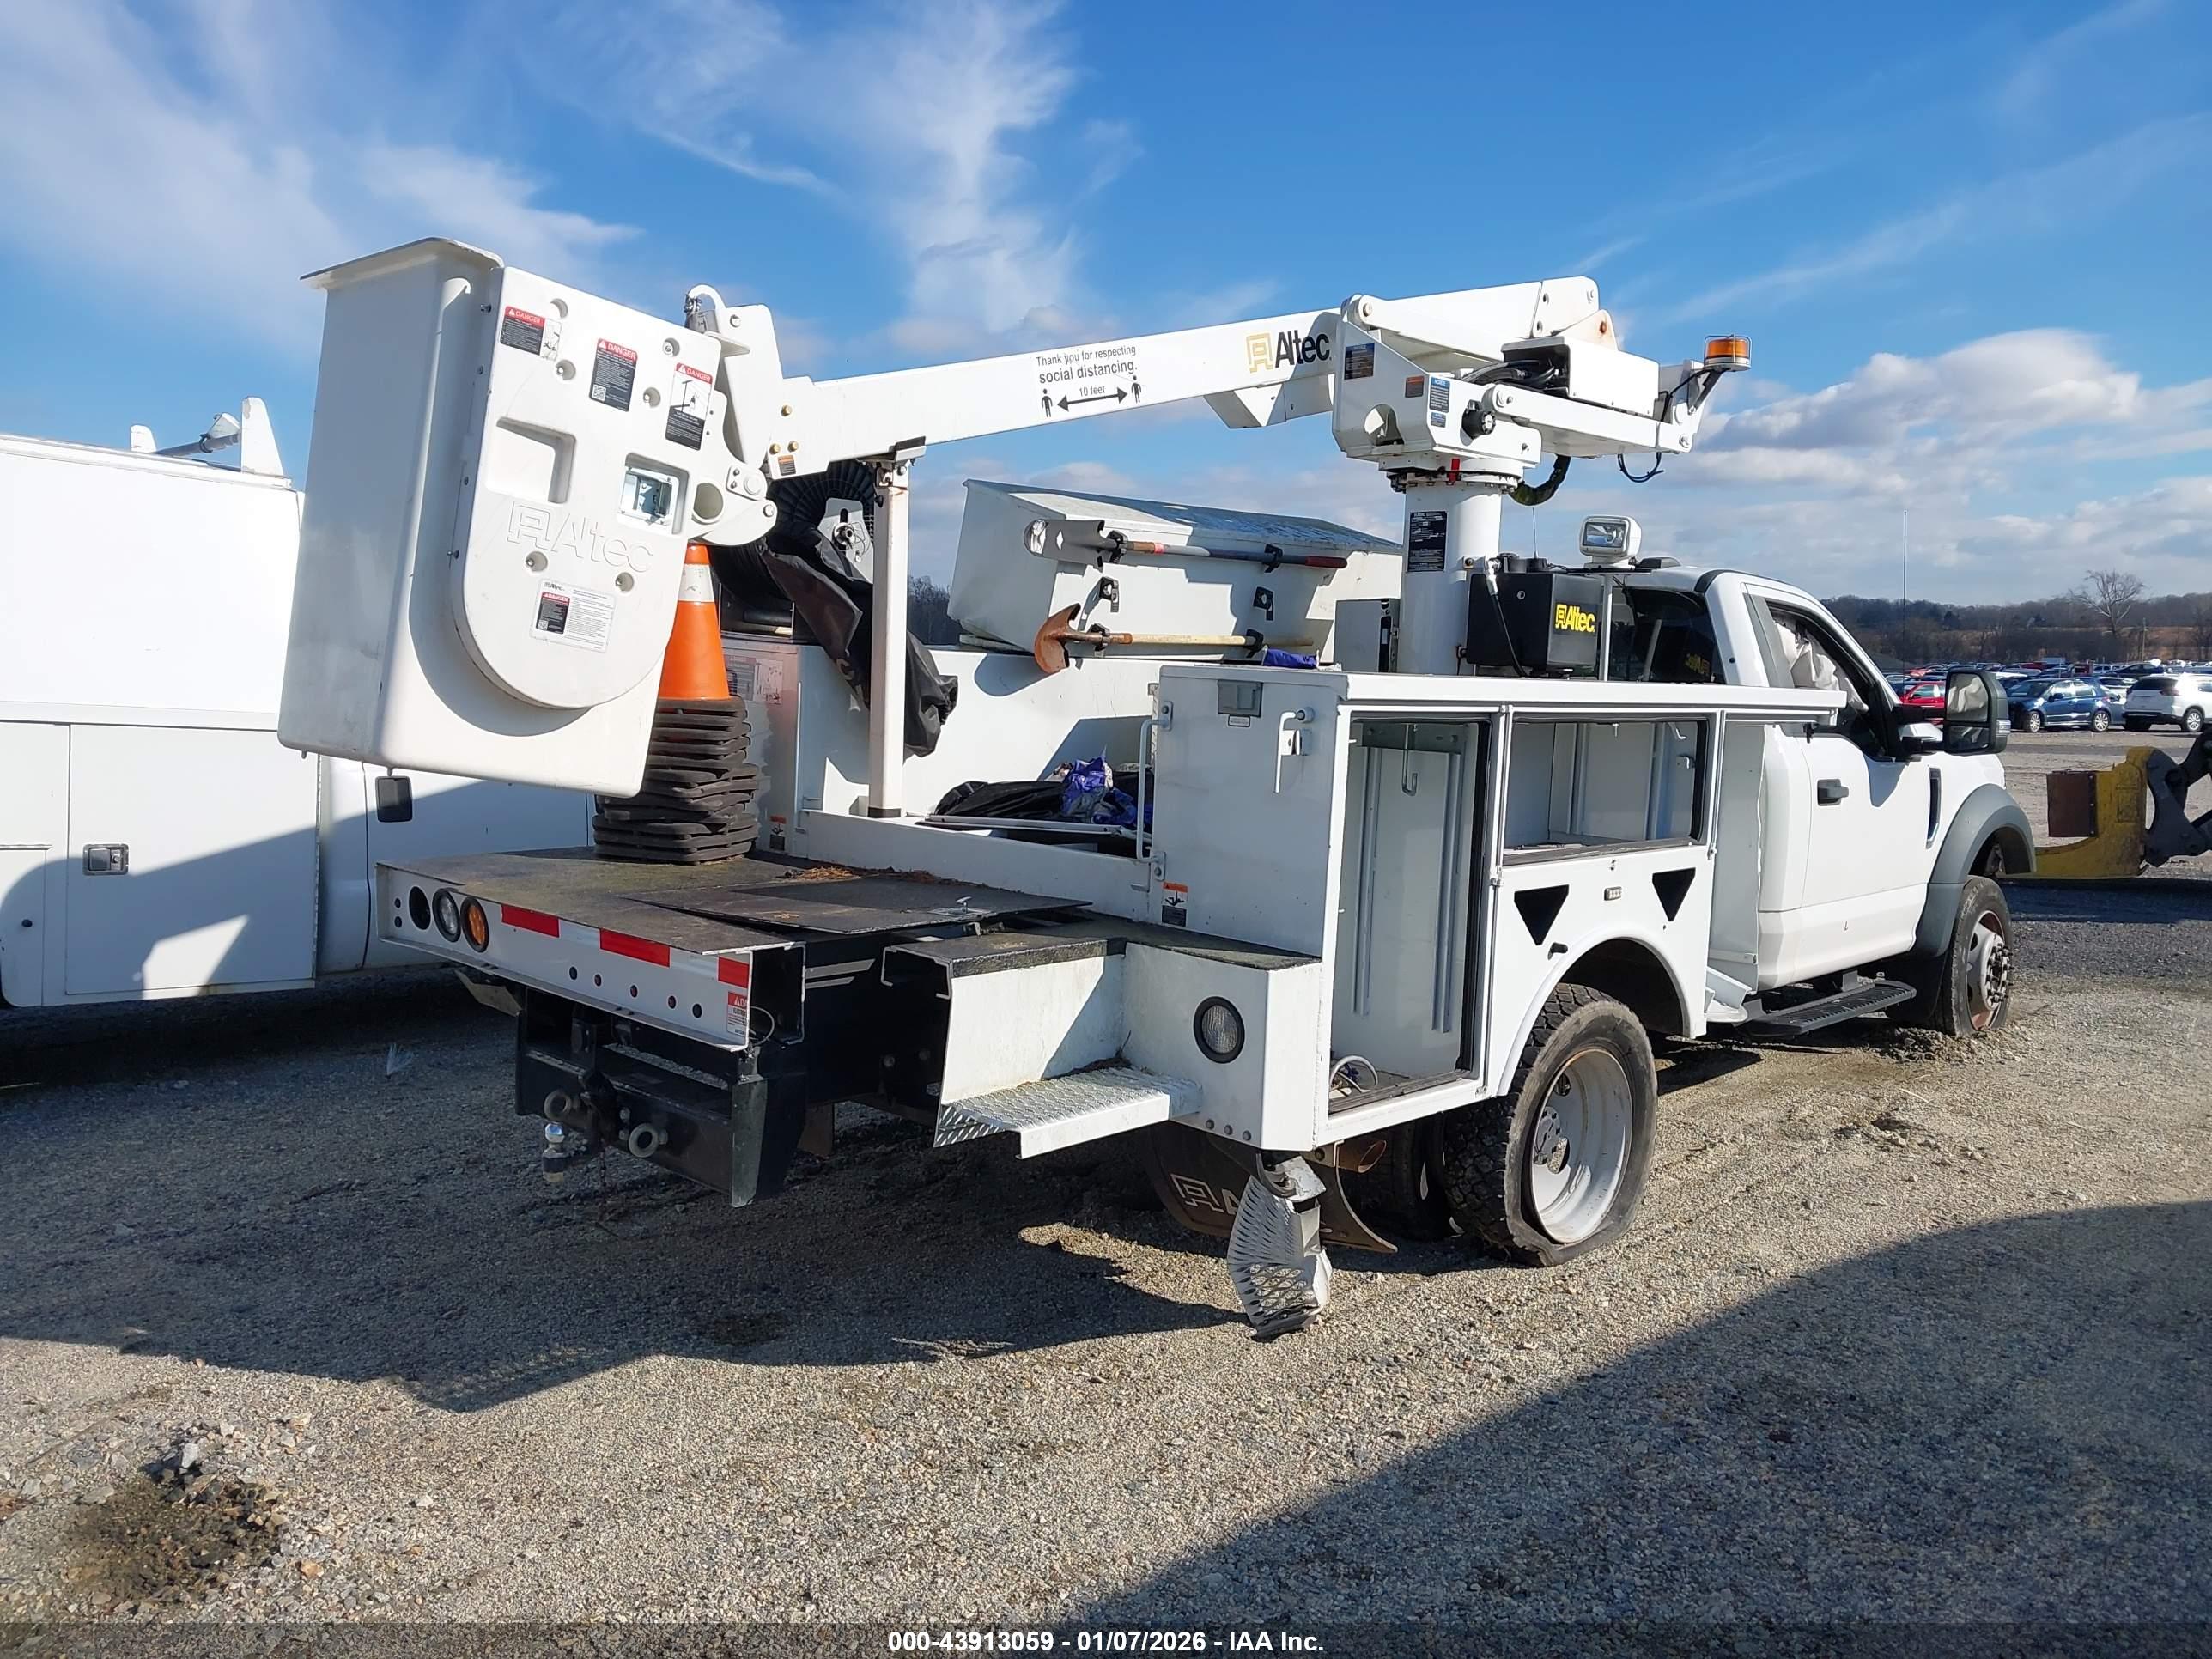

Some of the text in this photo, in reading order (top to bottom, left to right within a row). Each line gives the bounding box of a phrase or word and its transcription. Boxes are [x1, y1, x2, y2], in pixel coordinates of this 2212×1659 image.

[515, 310, 541, 324] DANGER
[607, 343, 636, 361] DANGER
[1036, 345, 1136, 367] Thank you for respecting
[686, 368, 709, 380] DANGER
[1039, 360, 1138, 384] social distancing.
[1079, 385, 1106, 397] 10 feet
[550, 514, 653, 573] Altec
